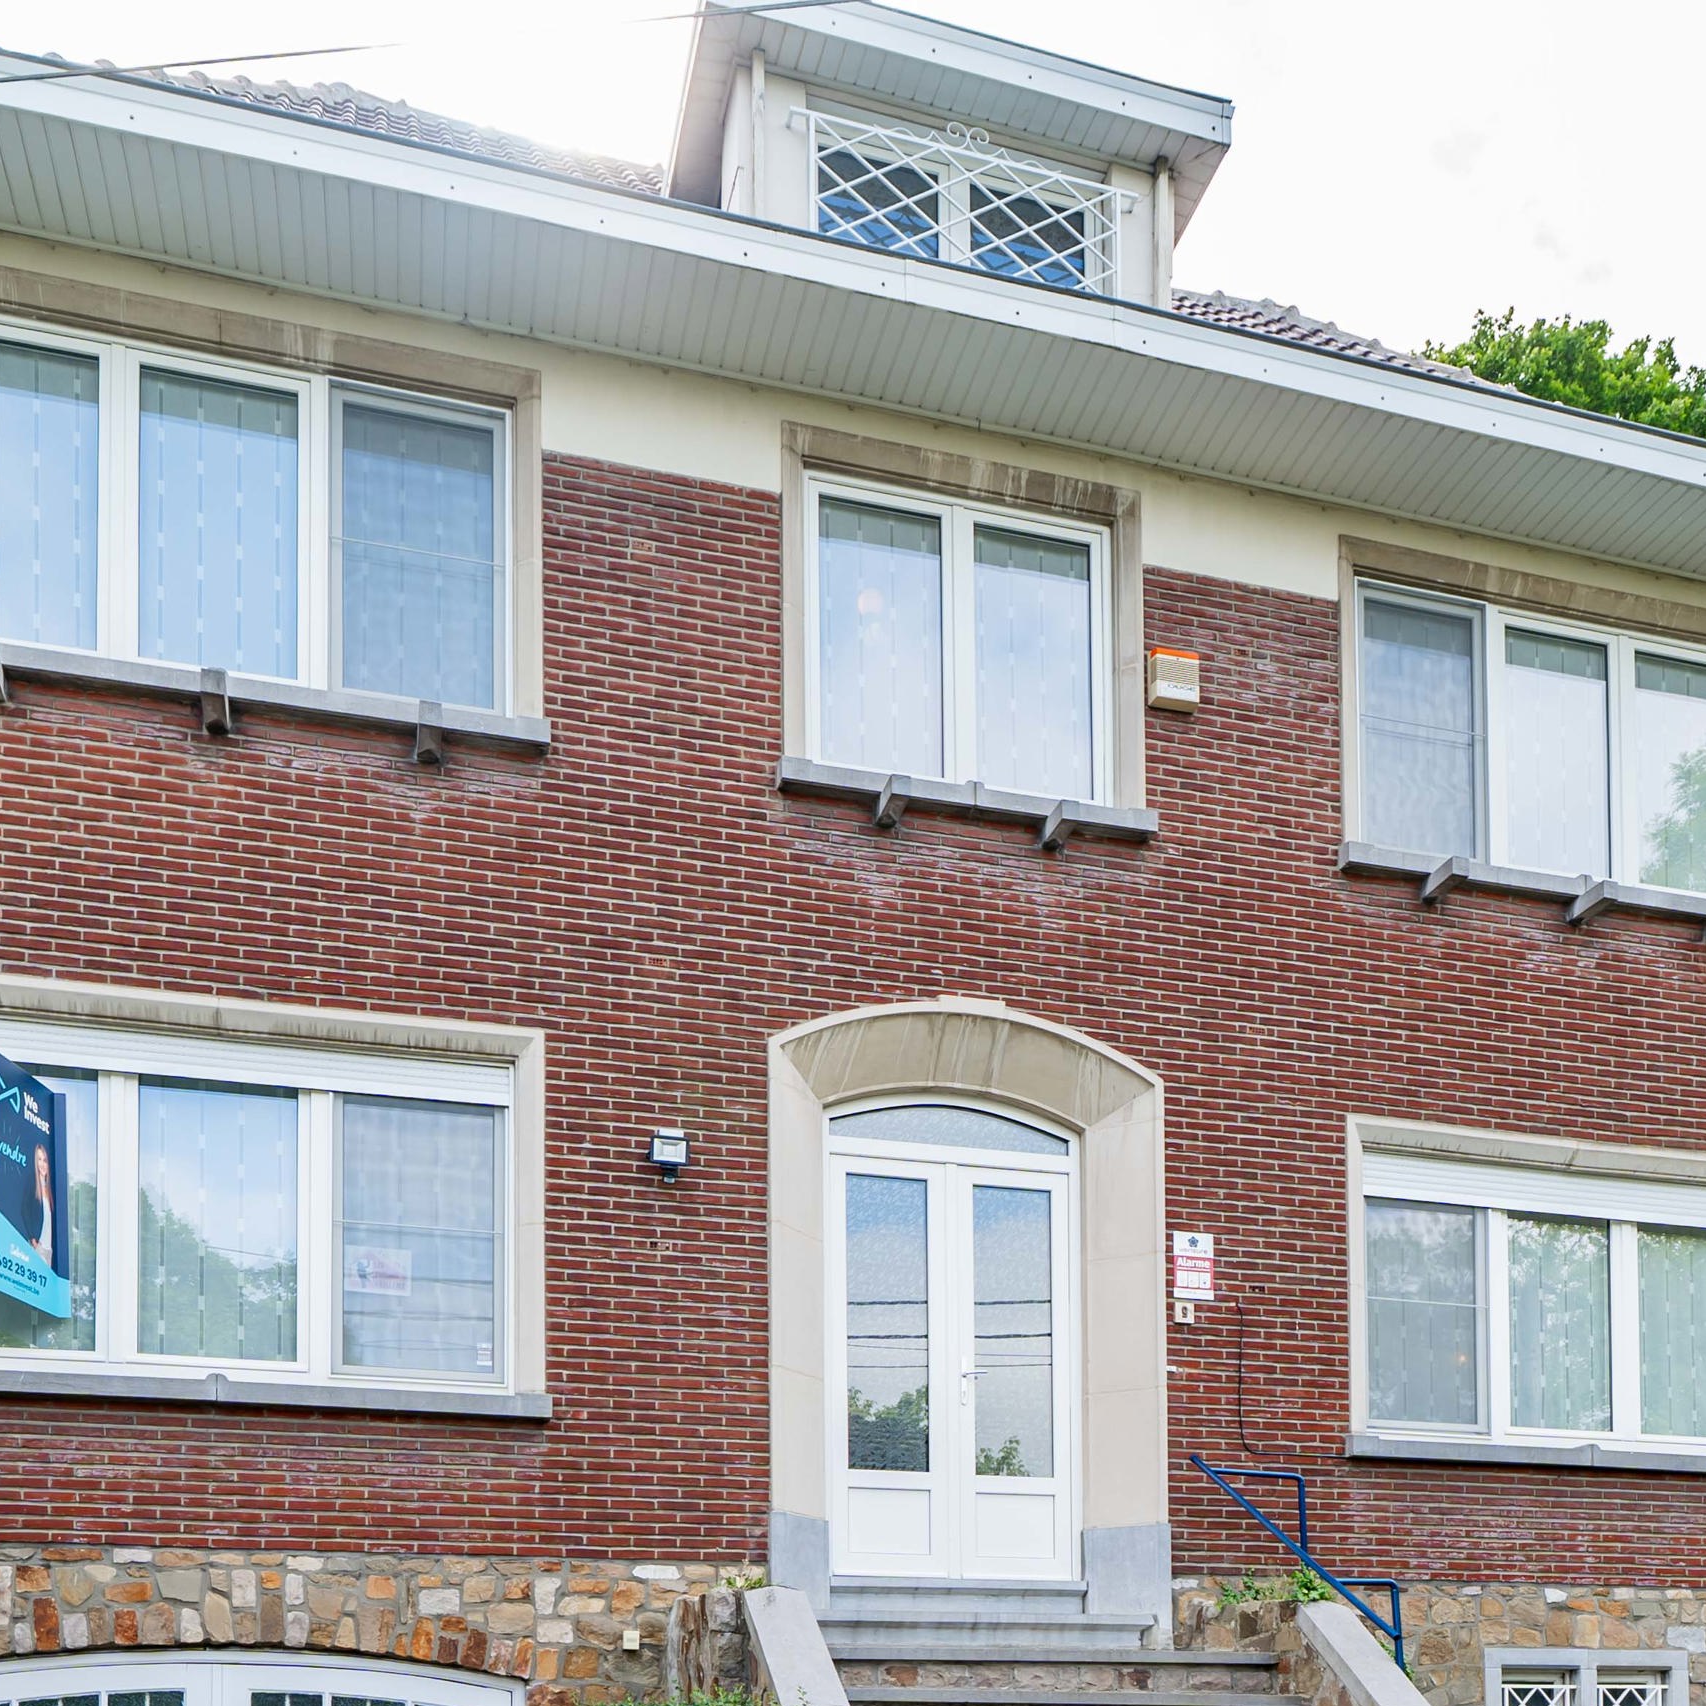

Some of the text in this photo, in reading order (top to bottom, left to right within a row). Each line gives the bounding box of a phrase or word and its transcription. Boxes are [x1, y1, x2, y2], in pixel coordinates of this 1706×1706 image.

[23, 1091, 39, 1114] We
[24, 1104, 50, 1135] Invest
[1176, 1256, 1211, 1269] Alarme
[14, 1262, 26, 1277] 29
[26, 1268, 38, 1283] 39
[38, 1274, 48, 1288] 17
